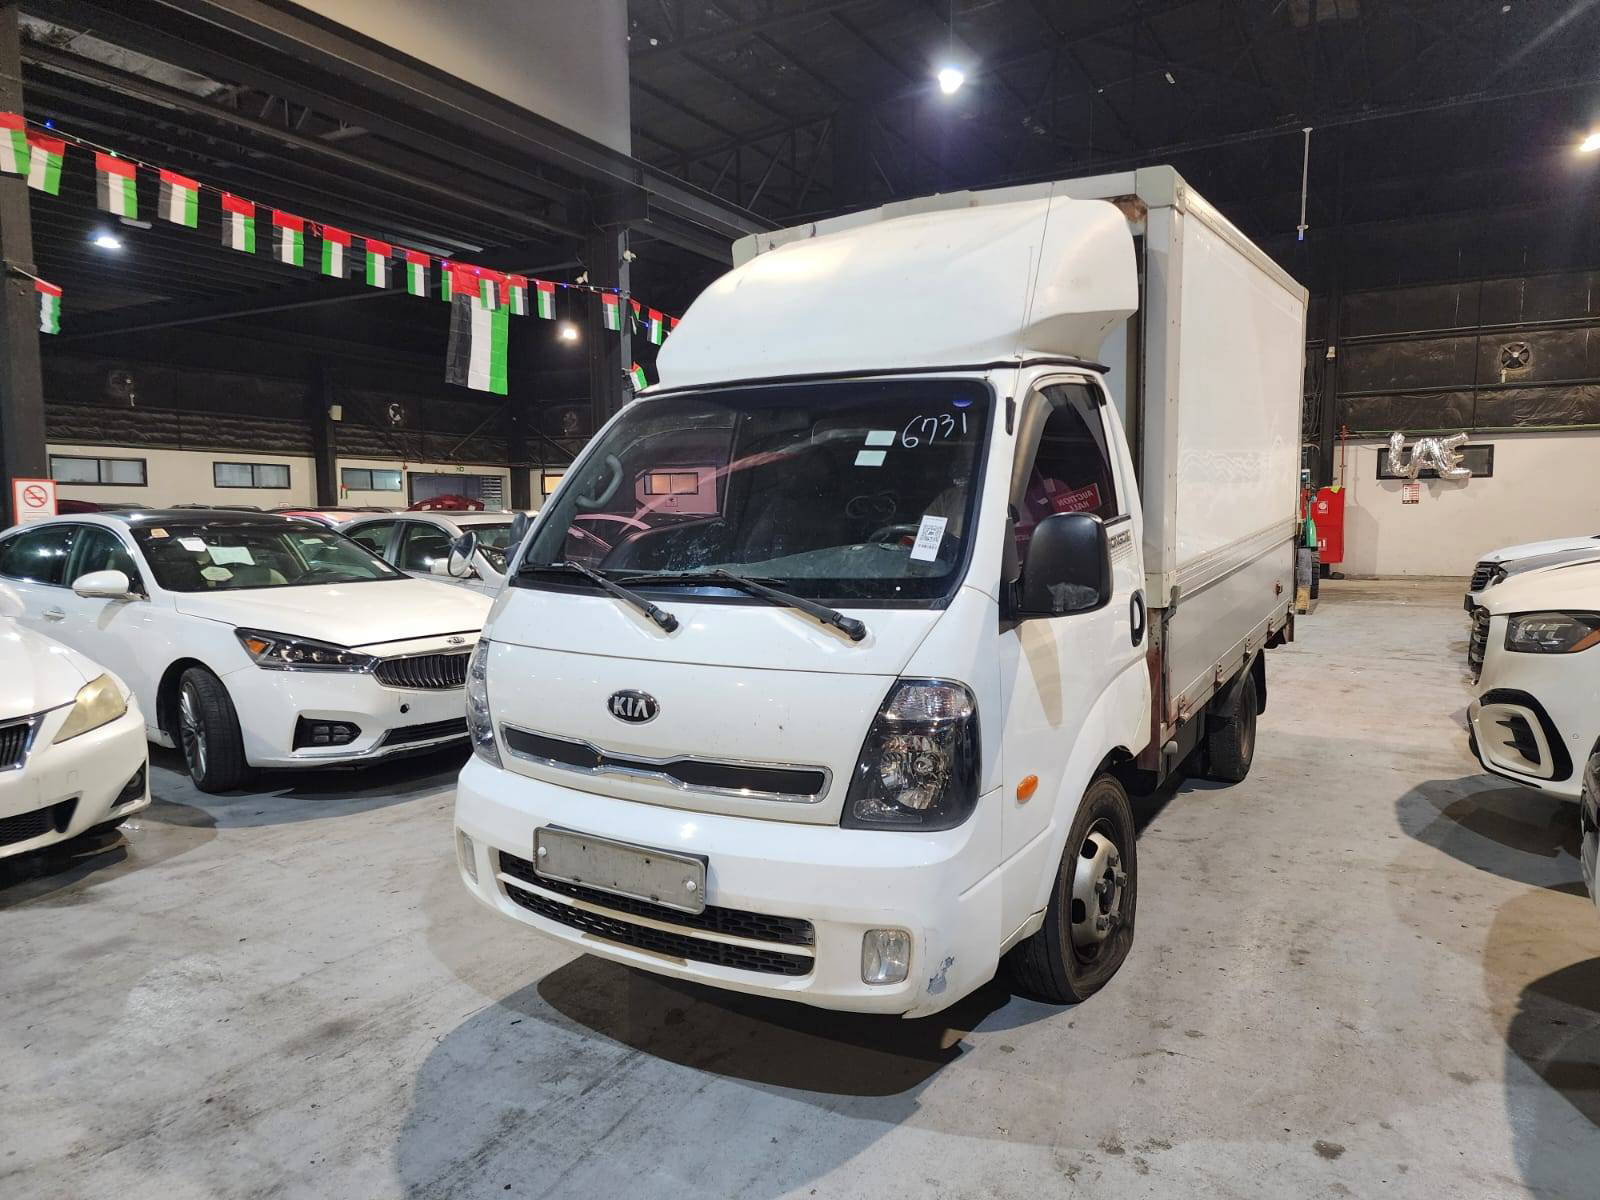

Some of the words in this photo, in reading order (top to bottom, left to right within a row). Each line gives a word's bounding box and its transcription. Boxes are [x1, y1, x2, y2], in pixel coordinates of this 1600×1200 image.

[902, 412, 967, 448] 6731
[1388, 432, 1472, 479] UAE
[613, 696, 649, 718] KIA
